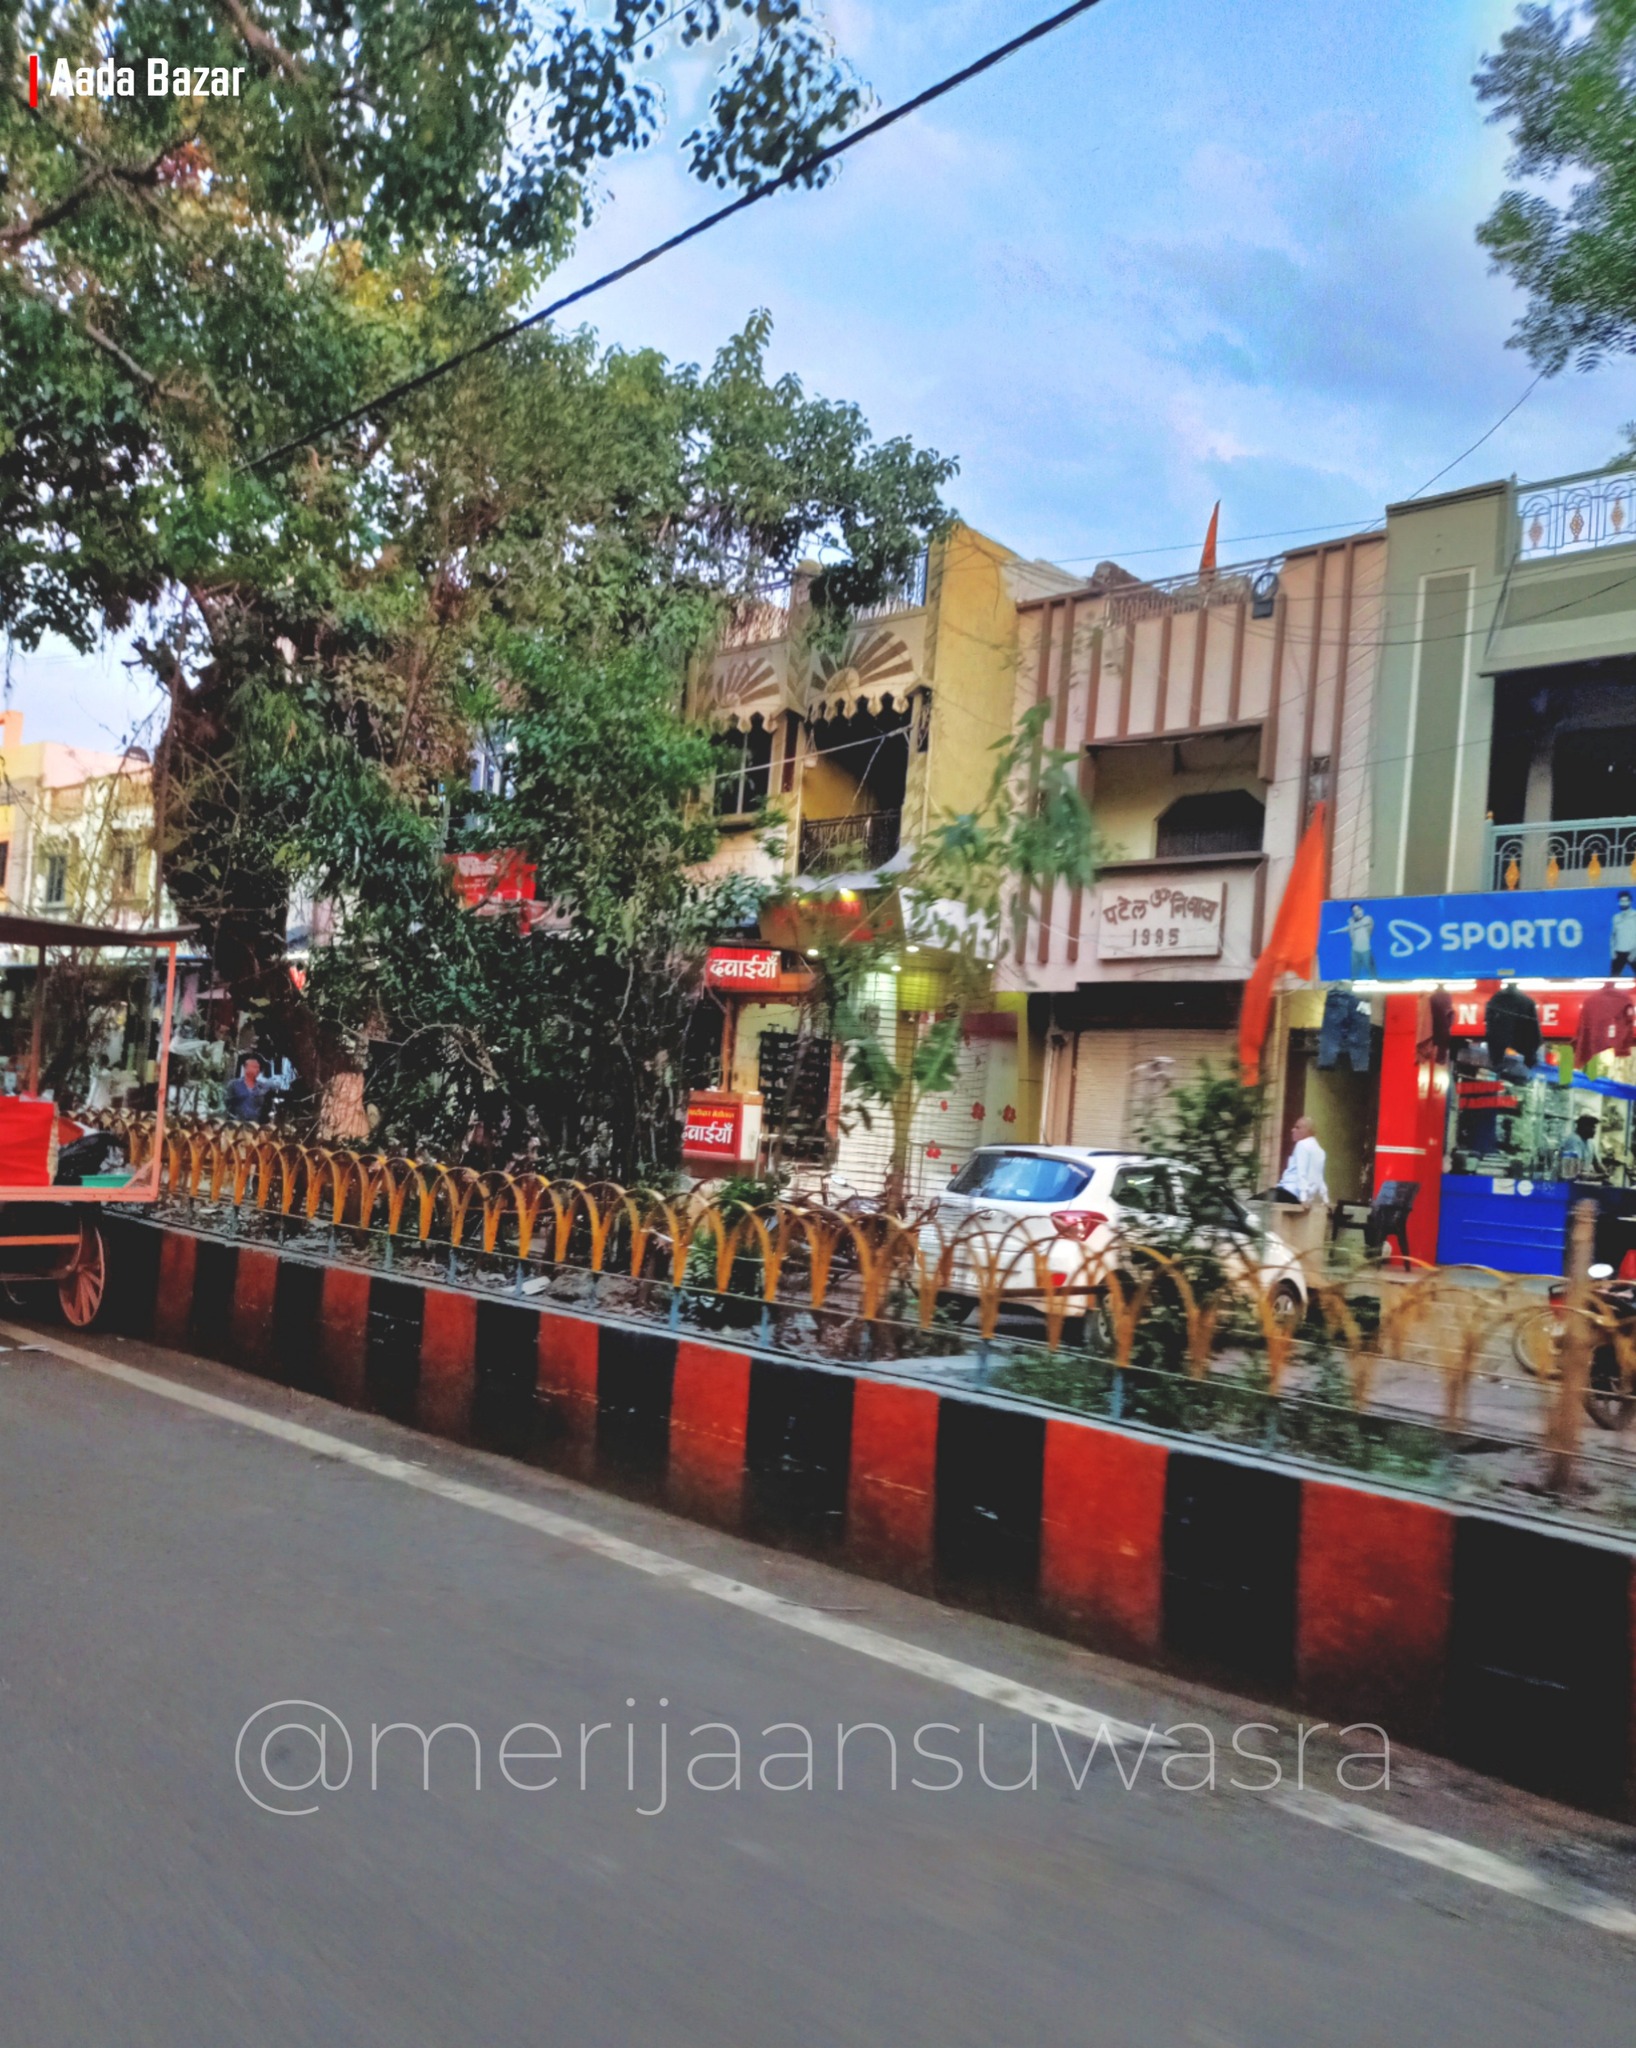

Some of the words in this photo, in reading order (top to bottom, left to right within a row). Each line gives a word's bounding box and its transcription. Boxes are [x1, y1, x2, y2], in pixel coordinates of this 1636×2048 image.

[1103, 896, 1148, 925] पटेल
[1169, 890, 1219, 923] निवास
[1131, 927, 1181, 948] 1995
[1439, 918, 1584, 951] SPORTO
[709, 954, 778, 979] दवाईयाँ
